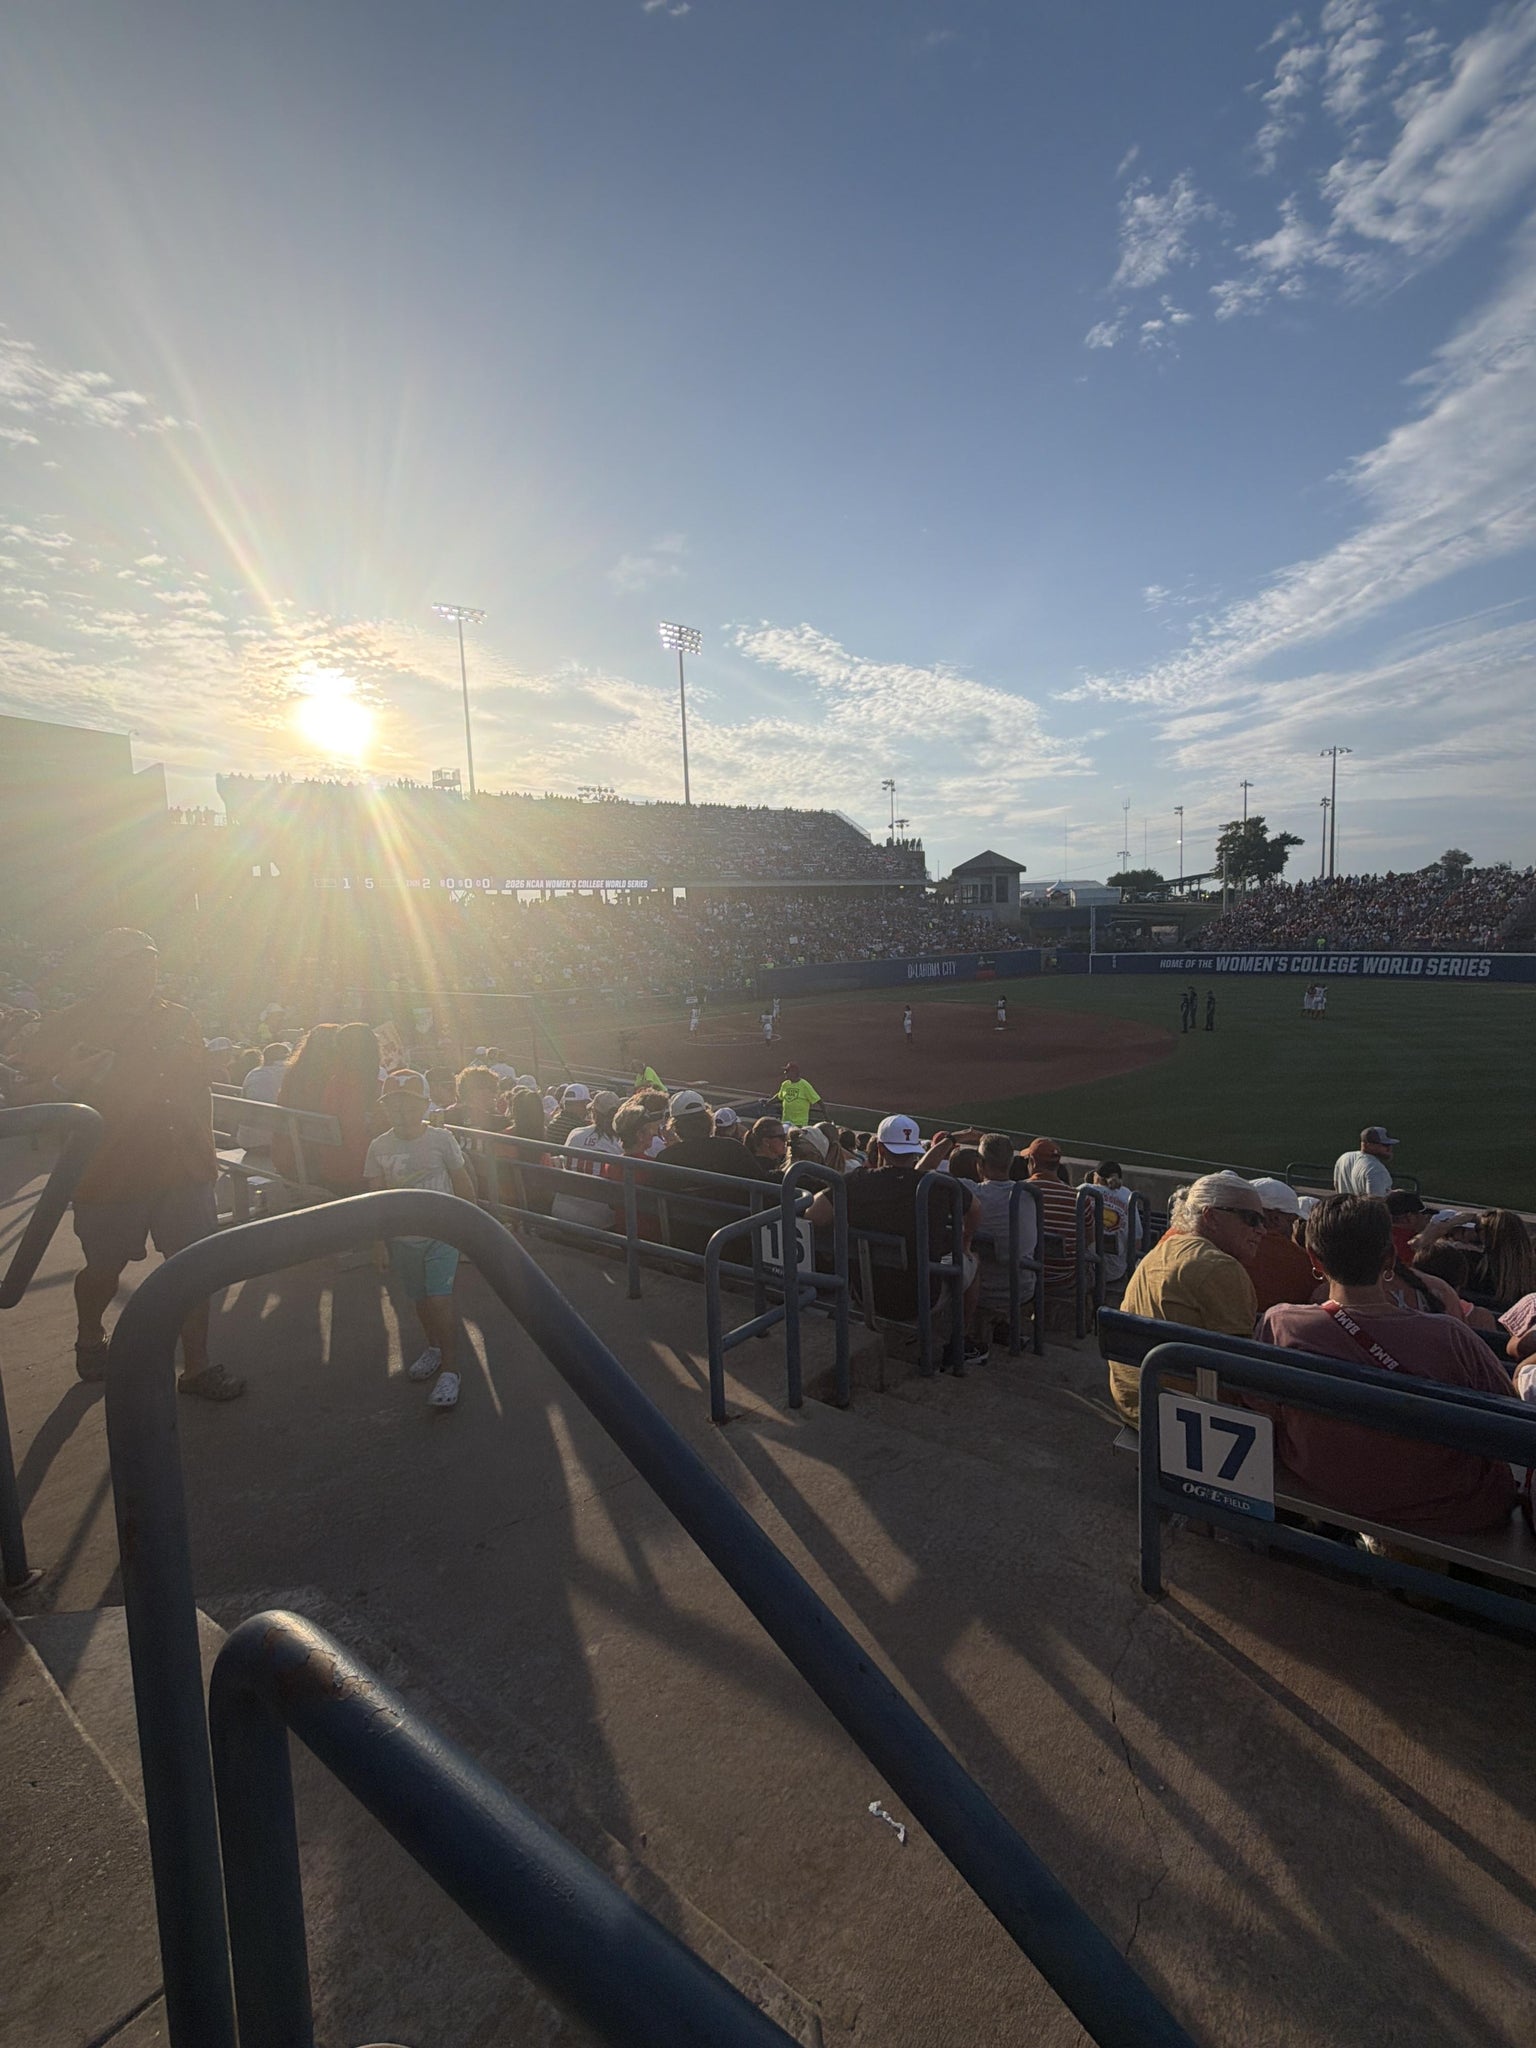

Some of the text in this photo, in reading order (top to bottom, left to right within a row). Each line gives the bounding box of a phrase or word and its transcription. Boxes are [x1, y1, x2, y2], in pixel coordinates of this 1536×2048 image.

[343, 878, 351, 888] 1
[364, 878, 374, 888] 5
[422, 878, 431, 888] 2
[505, 880, 648, 888] 2026 NCAA WOMEN'S COLLEGE WORLD SERIES
[942, 961, 956, 976] CITY
[1160, 956, 1492, 977] HOME OF THE WOMEN'S COLLEGE WORLD SERIES
[1334, 1309, 1400, 1370] BAMA BAMA
[1176, 1407, 1256, 1481] 17
[1223, 1496, 1251, 1510] FIELD
